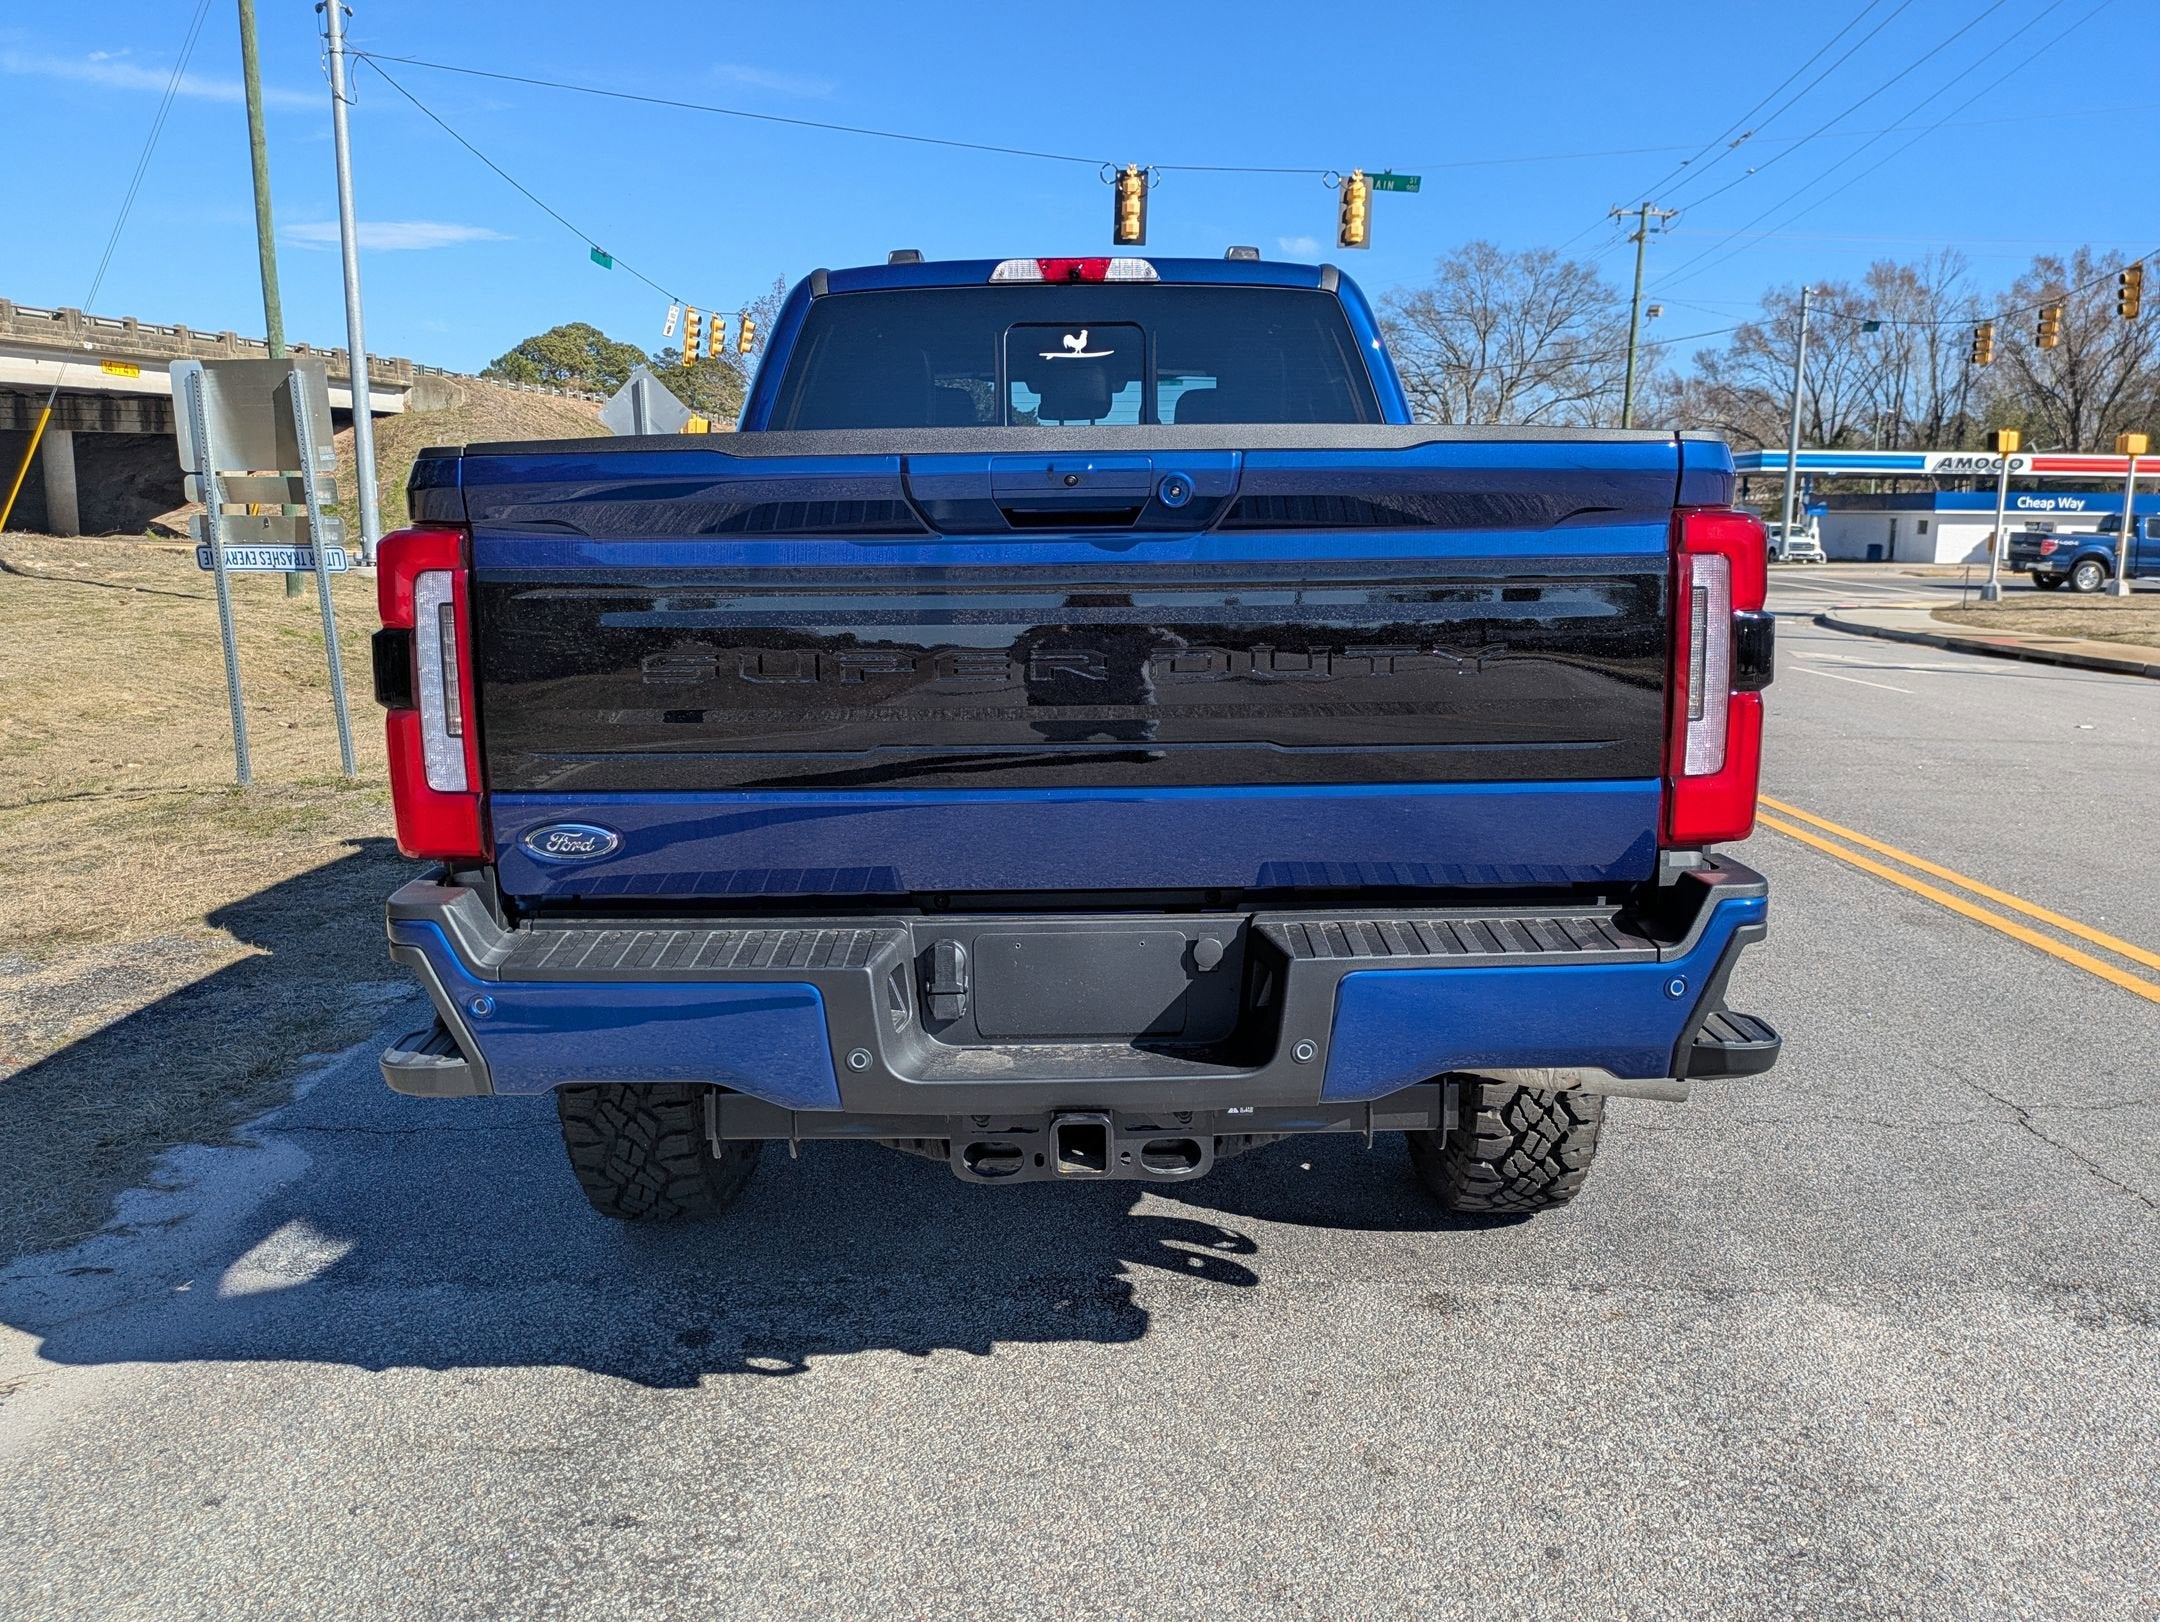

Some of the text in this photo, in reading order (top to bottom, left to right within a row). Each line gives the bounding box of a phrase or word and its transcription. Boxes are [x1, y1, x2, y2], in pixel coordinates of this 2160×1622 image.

[1374, 180, 1394, 190] AIN
[1937, 457, 2025, 471] AMOCO
[2017, 496, 2085, 511] Cheap Way
[261, 551, 307, 566] TRASHES
[309, 551, 342, 567] LITR
[641, 645, 1508, 684] SUPER DUTY
[546, 832, 596, 852] Ford
